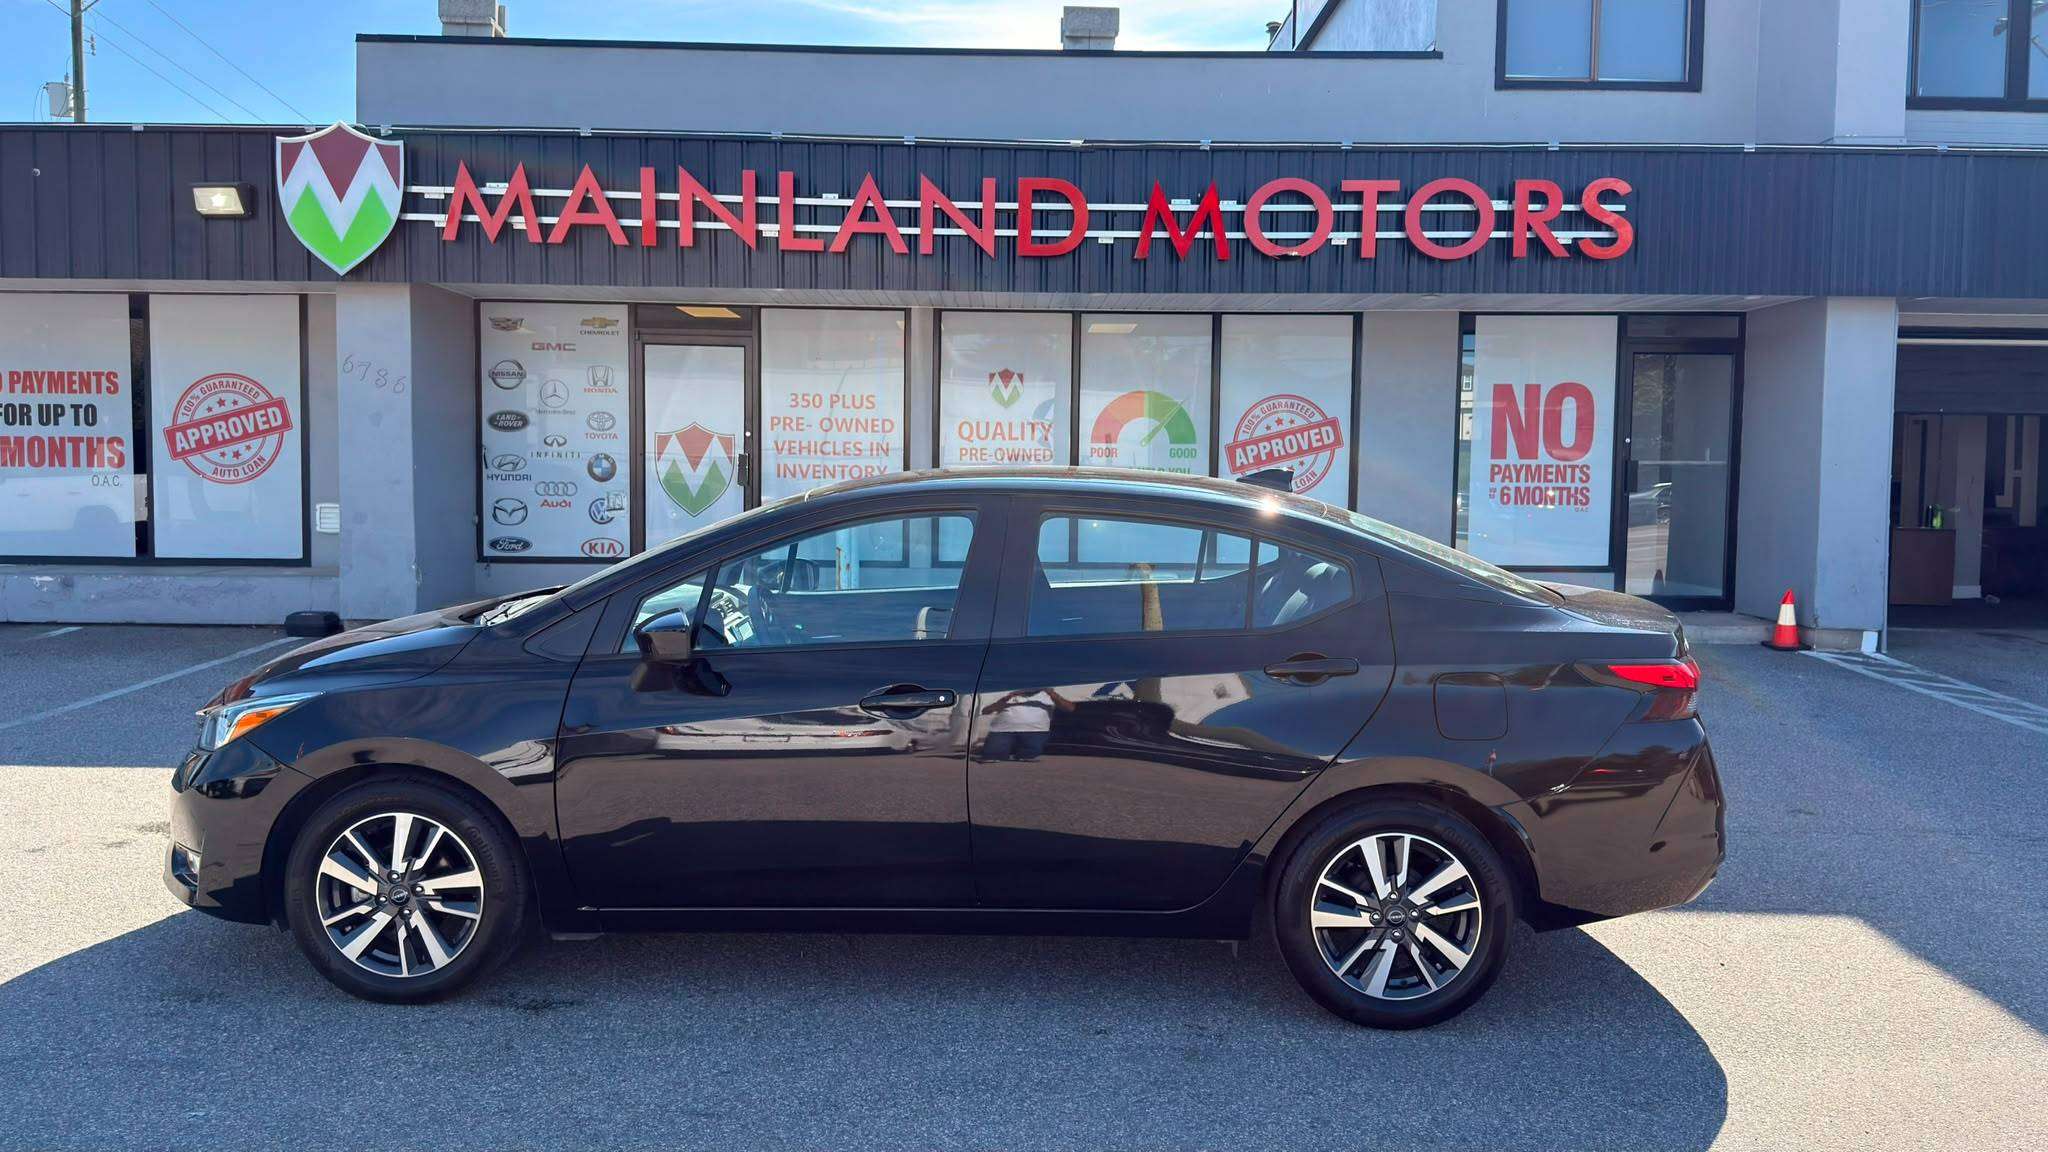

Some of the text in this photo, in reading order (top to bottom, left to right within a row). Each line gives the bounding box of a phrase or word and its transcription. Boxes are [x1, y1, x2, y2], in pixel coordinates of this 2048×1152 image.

[442, 160, 1634, 261] MAINLAND MOTORS
[532, 342, 576, 351] GMC
[9, 371, 119, 395] PAYMENTS
[342, 354, 407, 393] 6786
[182, 380, 260, 417] 100% GUARANTEED
[789, 393, 876, 410] 350 PLUS
[38, 403, 66, 426] UP
[70, 403, 98, 427] TO
[1260, 399, 1316, 419] GUARANTEED
[175, 406, 283, 453] APPROVED
[819, 417, 894, 433] OWNED
[958, 420, 1053, 443] QUALITY
[1490, 382, 1595, 461] NO
[585, 432, 618, 440] TOYOTA
[0, 435, 126, 469] MONTHS
[774, 440, 890, 457] VEHICLES IN
[959, 447, 1054, 462] PRE-OWNED
[1090, 447, 1118, 458] POOR
[1168, 447, 1197, 459] GOOD
[1234, 425, 1335, 468] APPROVED
[212, 455, 267, 478] AUTO LOAN
[777, 463, 888, 480] INVENTORY
[1490, 464, 1591, 484] PAYMENTS
[540, 499, 572, 508] Audi
[1500, 486, 1511, 505] 6
[1514, 486, 1590, 506] MONTHS
[496, 537, 523, 550] Ford
[589, 543, 617, 554] KIA
